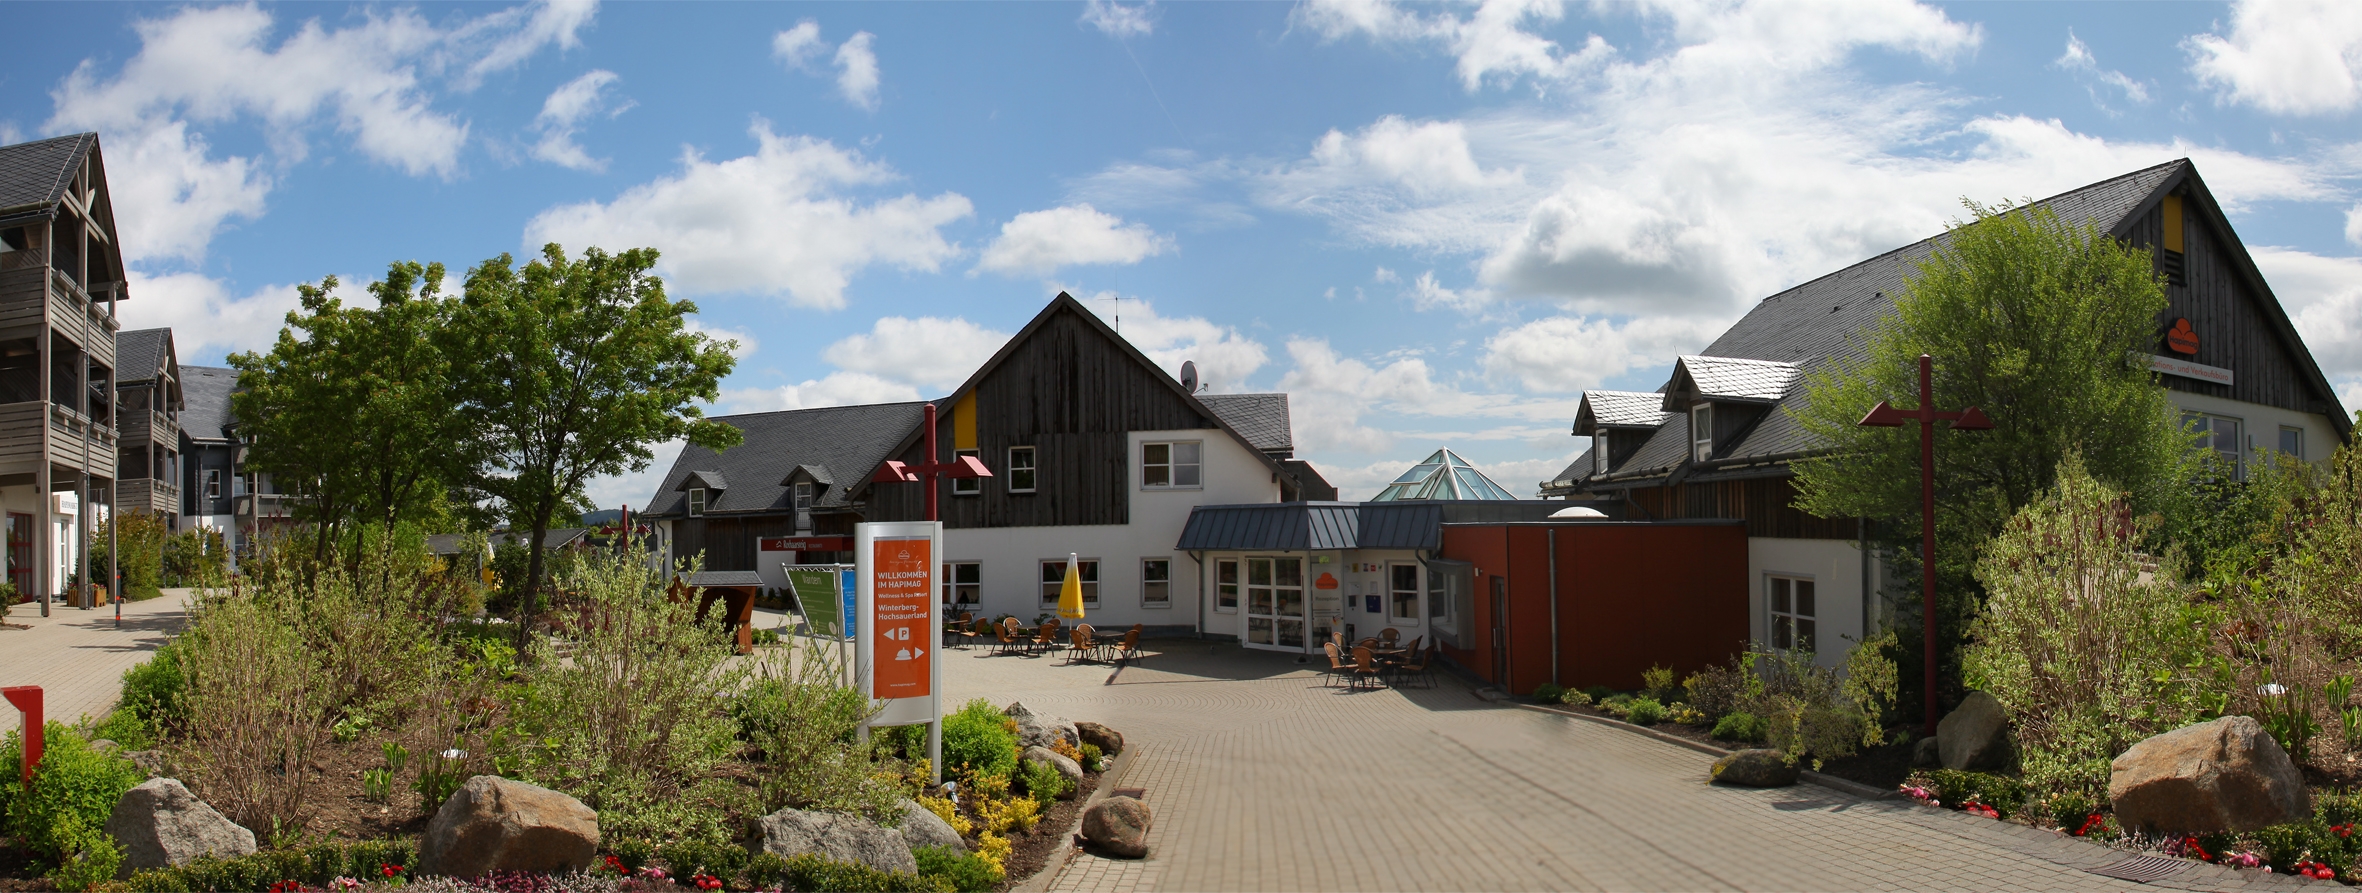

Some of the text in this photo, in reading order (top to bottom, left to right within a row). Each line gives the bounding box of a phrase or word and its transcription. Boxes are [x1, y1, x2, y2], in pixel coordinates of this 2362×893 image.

[2170, 336, 2198, 350] Hapimag
[2178, 364, 2190, 374] und
[2191, 366, 2228, 381] Verkaufsbüro
[878, 571, 928, 579] WILLKOMMEN
